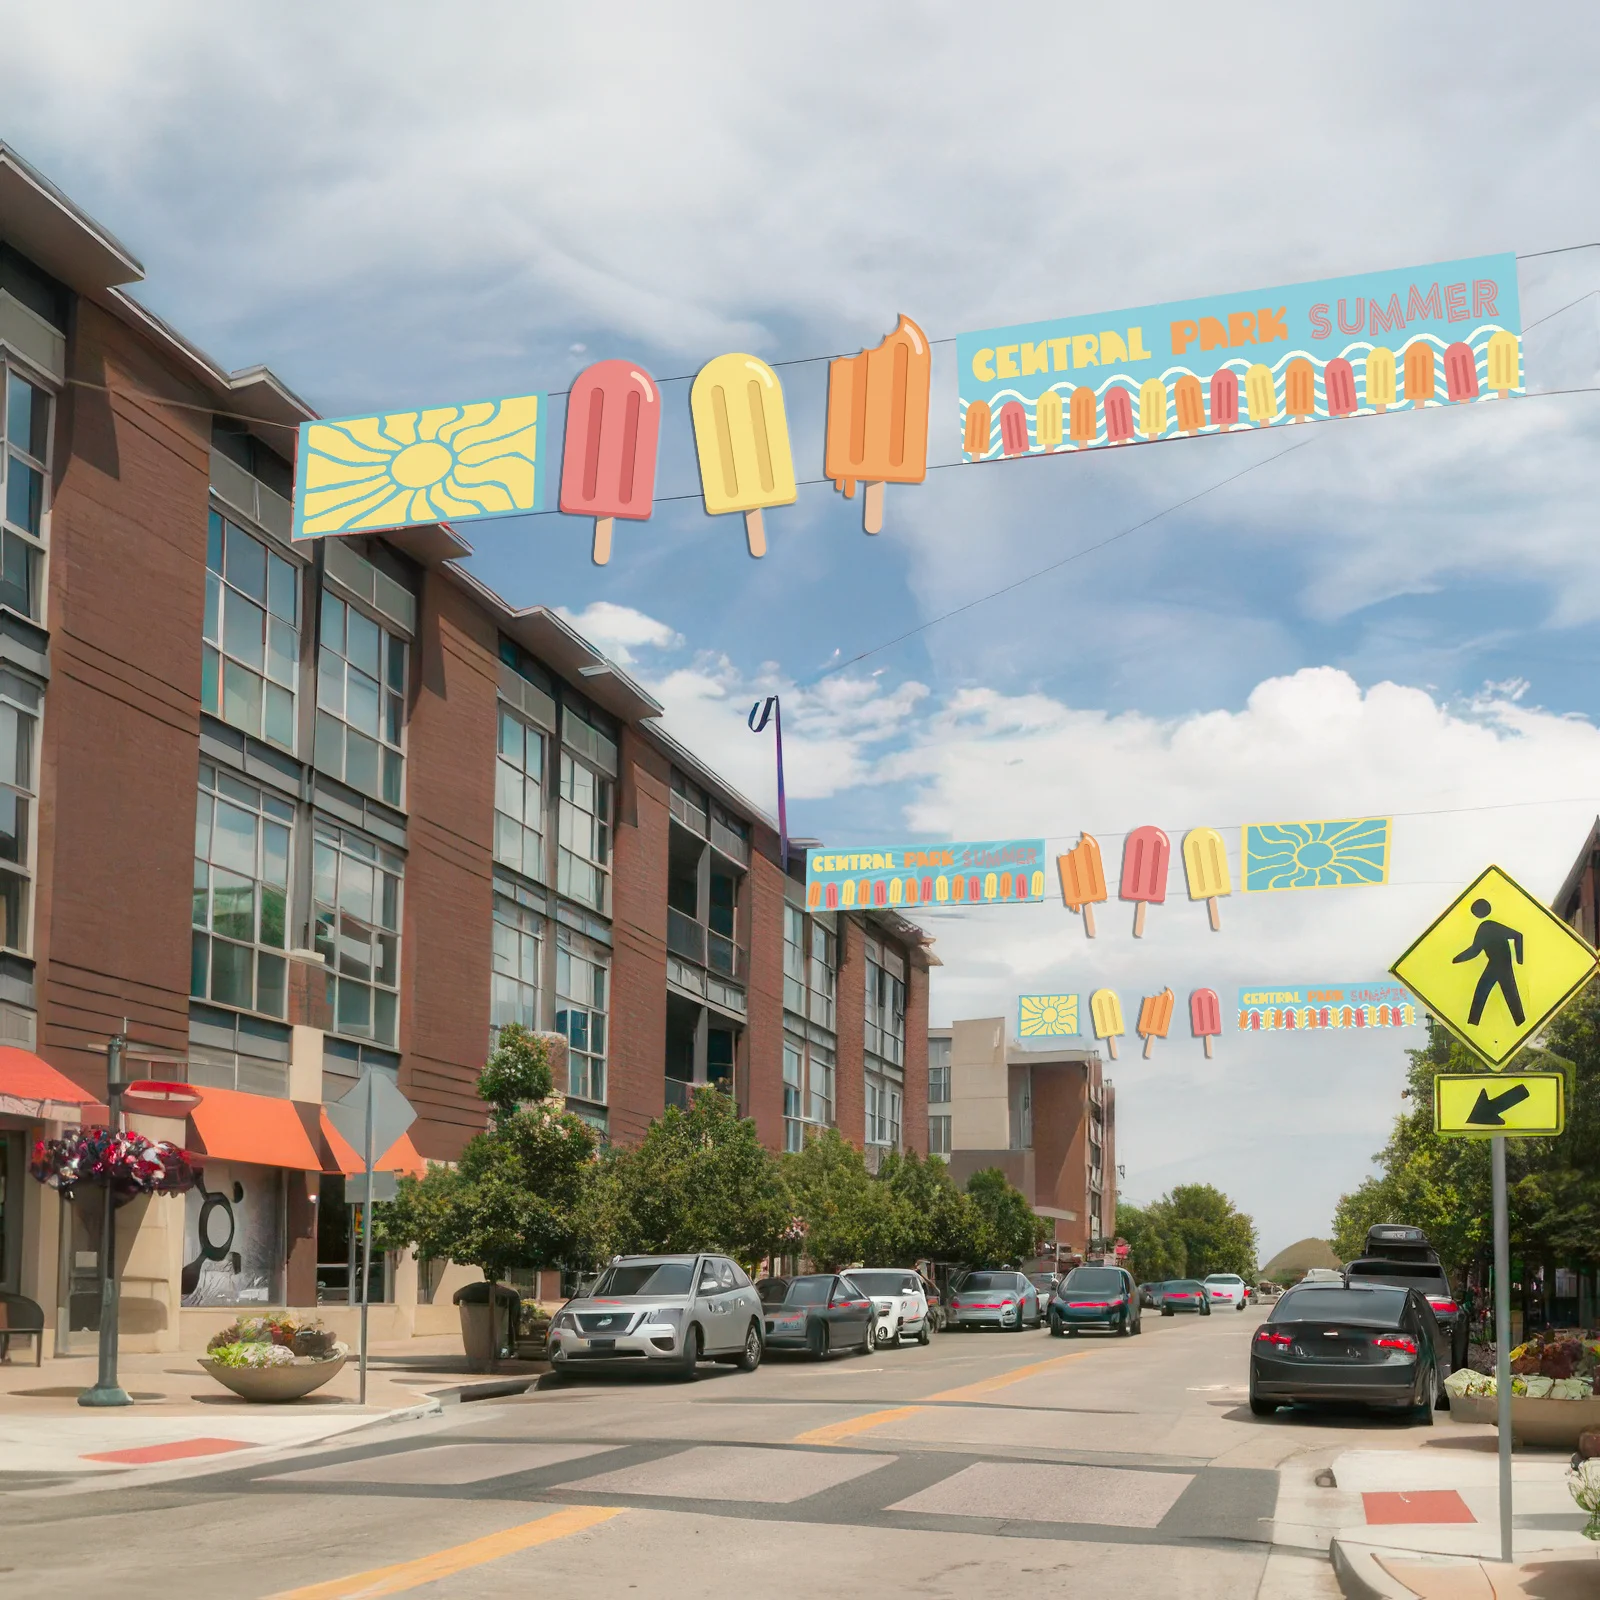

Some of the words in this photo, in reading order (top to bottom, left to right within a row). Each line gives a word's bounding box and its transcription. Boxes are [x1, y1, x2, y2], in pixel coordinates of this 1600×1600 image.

[972, 327, 1151, 382] CENTRAL
[1170, 306, 1288, 356] PARK
[1308, 279, 1500, 340] SUMMER
[812, 853, 896, 872] CENTRAL
[904, 850, 955, 868] PARK
[962, 847, 1037, 868] SUMMER
[1243, 991, 1302, 1005] CENTRAL
[1307, 990, 1344, 1003] PARK
